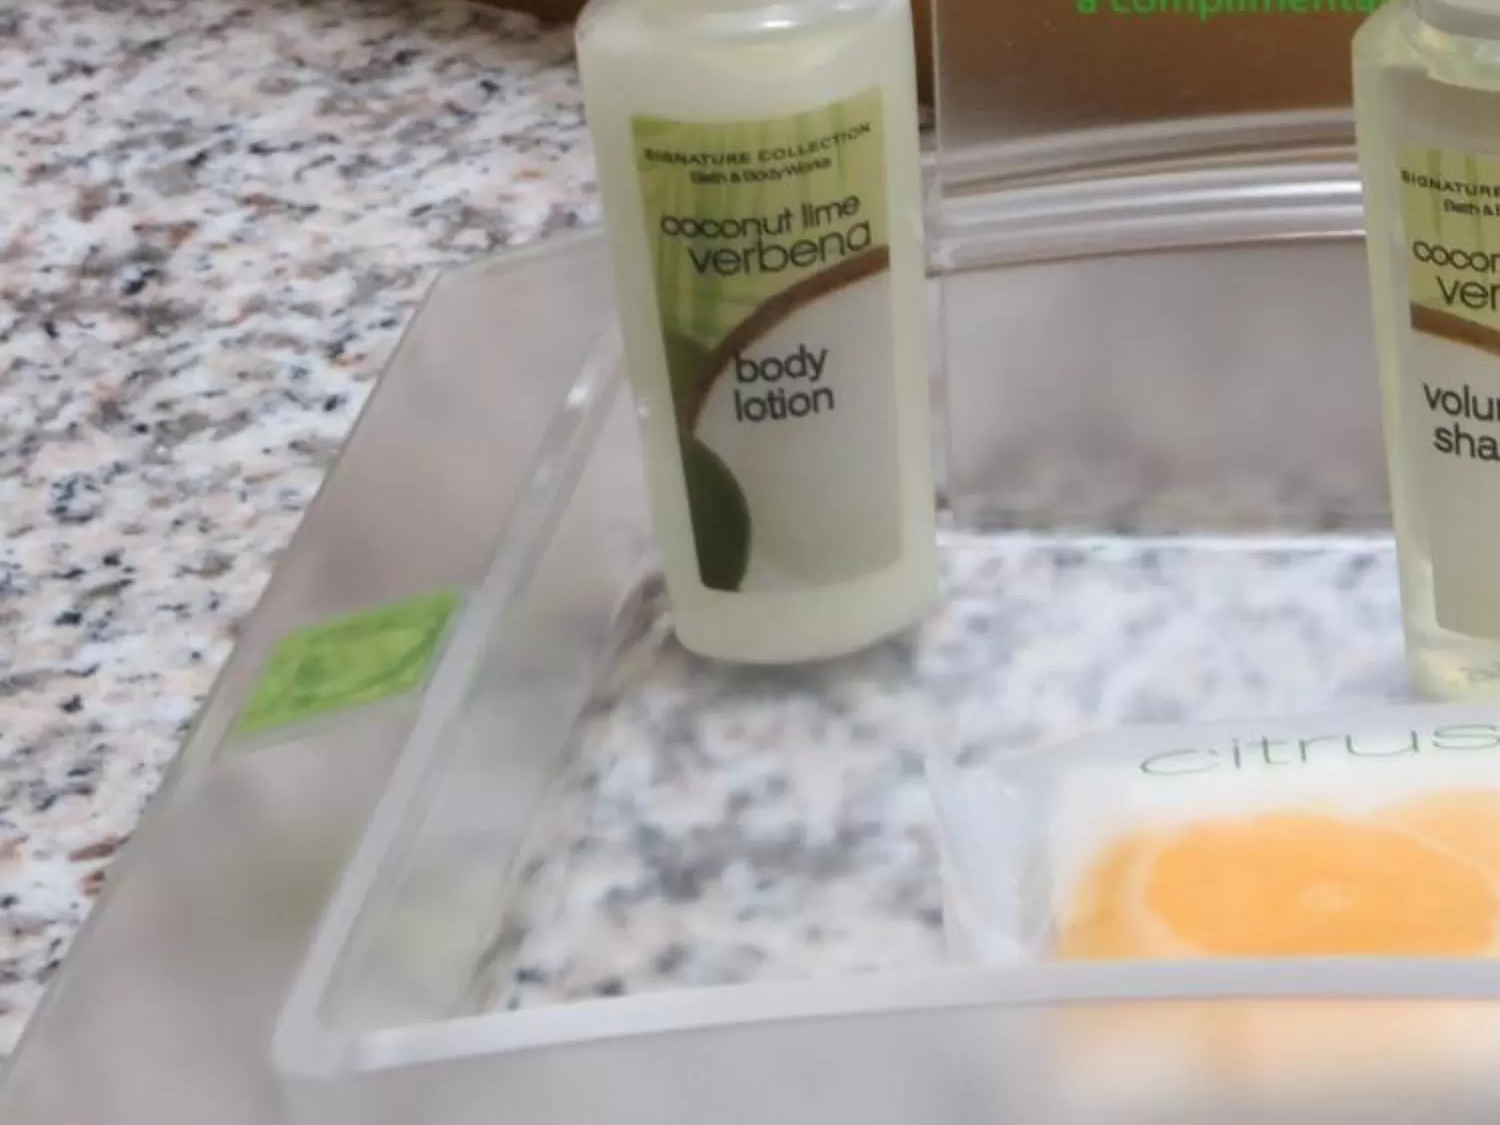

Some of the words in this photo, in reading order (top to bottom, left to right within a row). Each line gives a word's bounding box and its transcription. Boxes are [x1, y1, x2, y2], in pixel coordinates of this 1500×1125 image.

[642, 146, 750, 168] SIGNATURE
[757, 122, 872, 163] COLLECTION
[659, 206, 795, 240] coconut
[801, 194, 861, 230] lime
[1443, 198, 1480, 216] Bath
[1481, 203, 1495, 217] &
[687, 220, 873, 277] verbena
[733, 343, 829, 383] body
[733, 386, 835, 422] lotion
